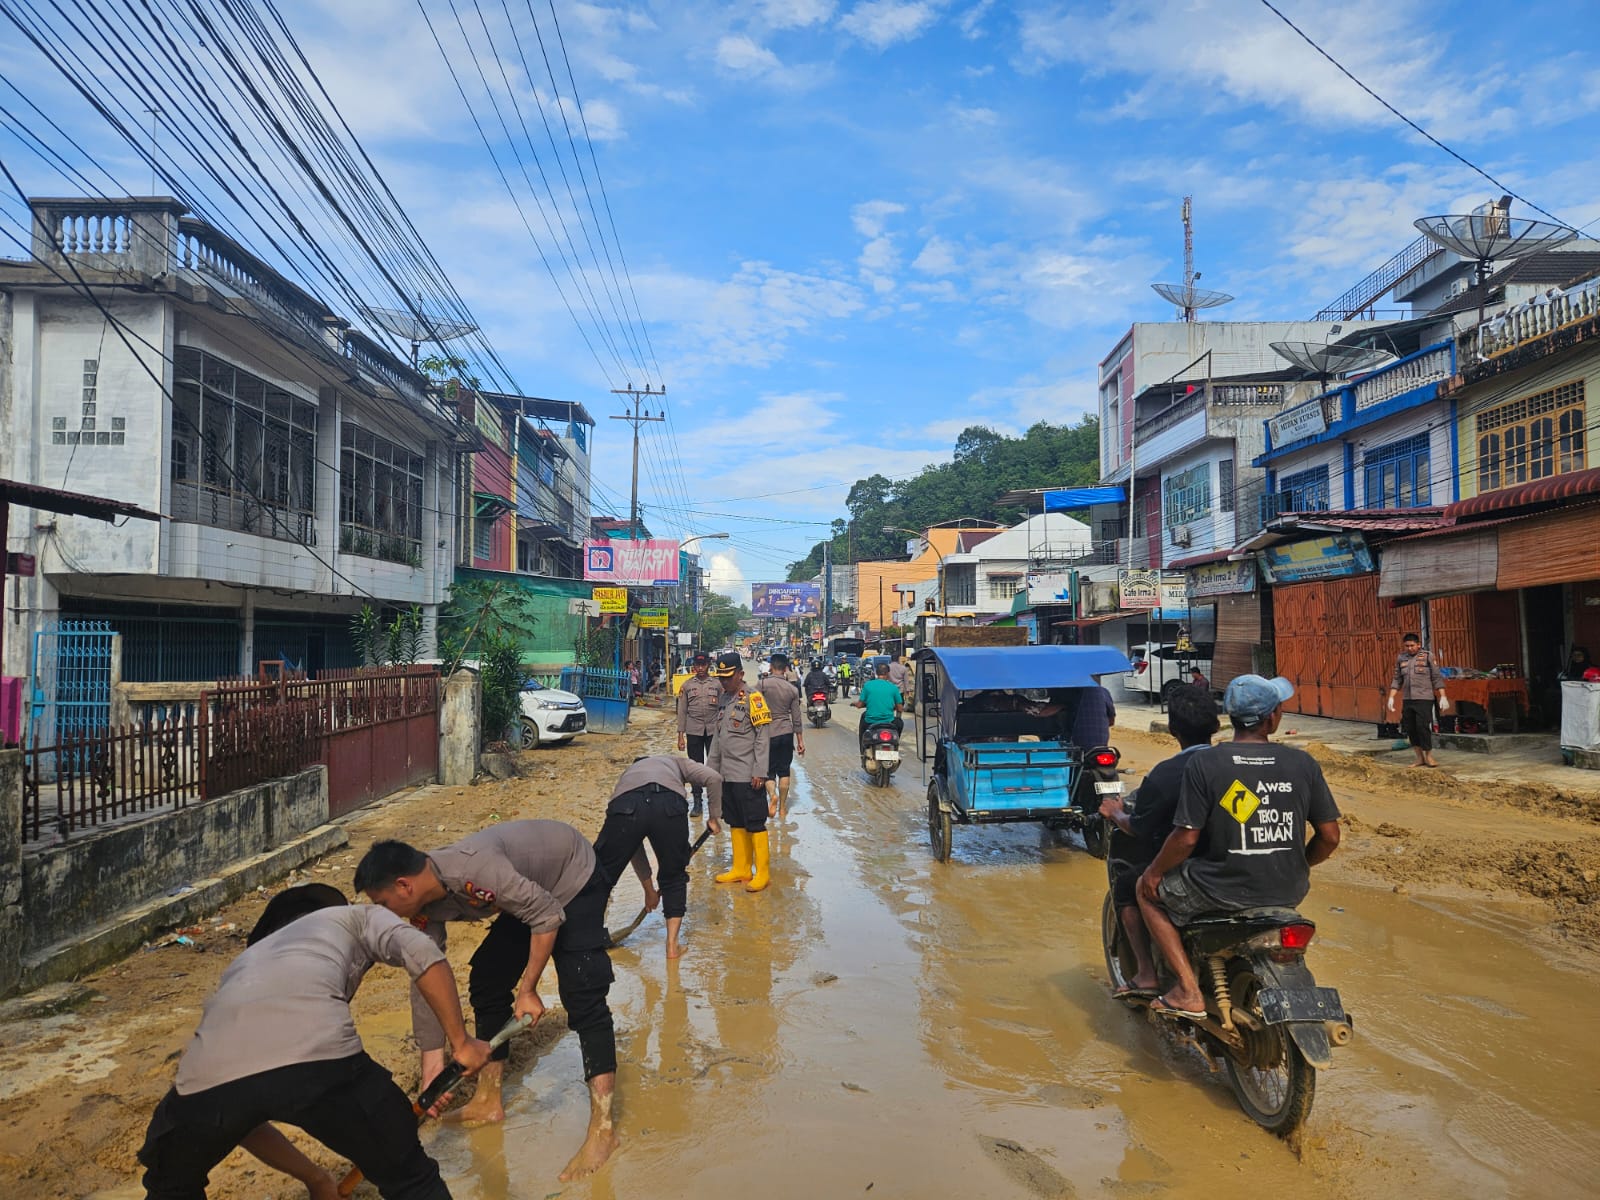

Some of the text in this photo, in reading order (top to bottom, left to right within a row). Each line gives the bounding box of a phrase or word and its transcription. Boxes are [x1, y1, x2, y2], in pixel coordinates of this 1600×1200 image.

[618, 548, 674, 561] NIPPON
[623, 560, 665, 571] PAINT
[1123, 587, 1157, 597] Cafe Irma 2
[1256, 781, 1292, 793] Awas
[1261, 795, 1270, 805] di
[1250, 825, 1293, 843] TEMAN
